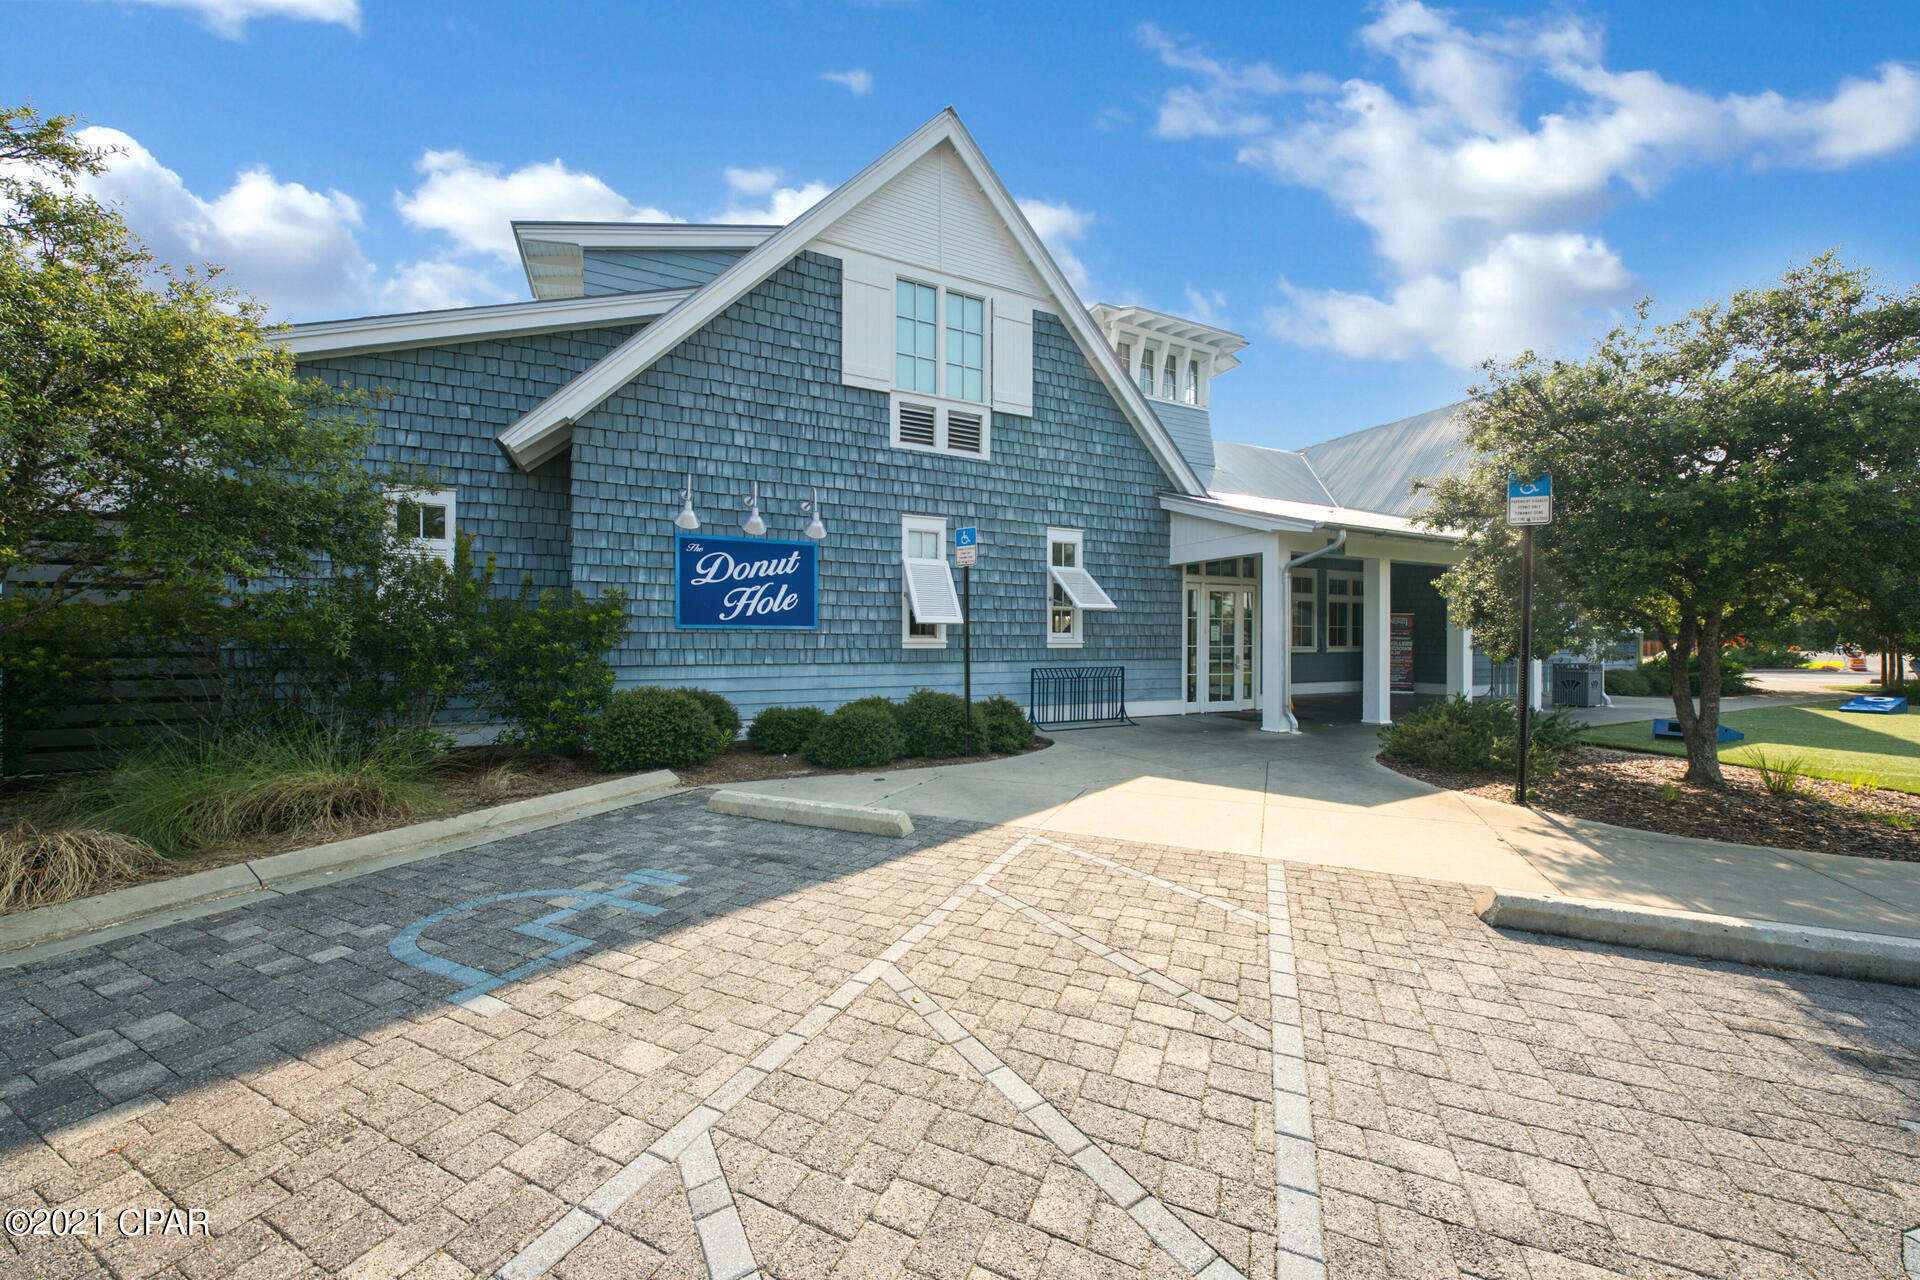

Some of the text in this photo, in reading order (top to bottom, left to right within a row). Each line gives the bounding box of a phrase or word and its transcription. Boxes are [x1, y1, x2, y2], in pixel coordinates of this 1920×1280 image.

[686, 543, 704, 552] The
[690, 550, 801, 586] Donut
[718, 582, 799, 620] Hole
